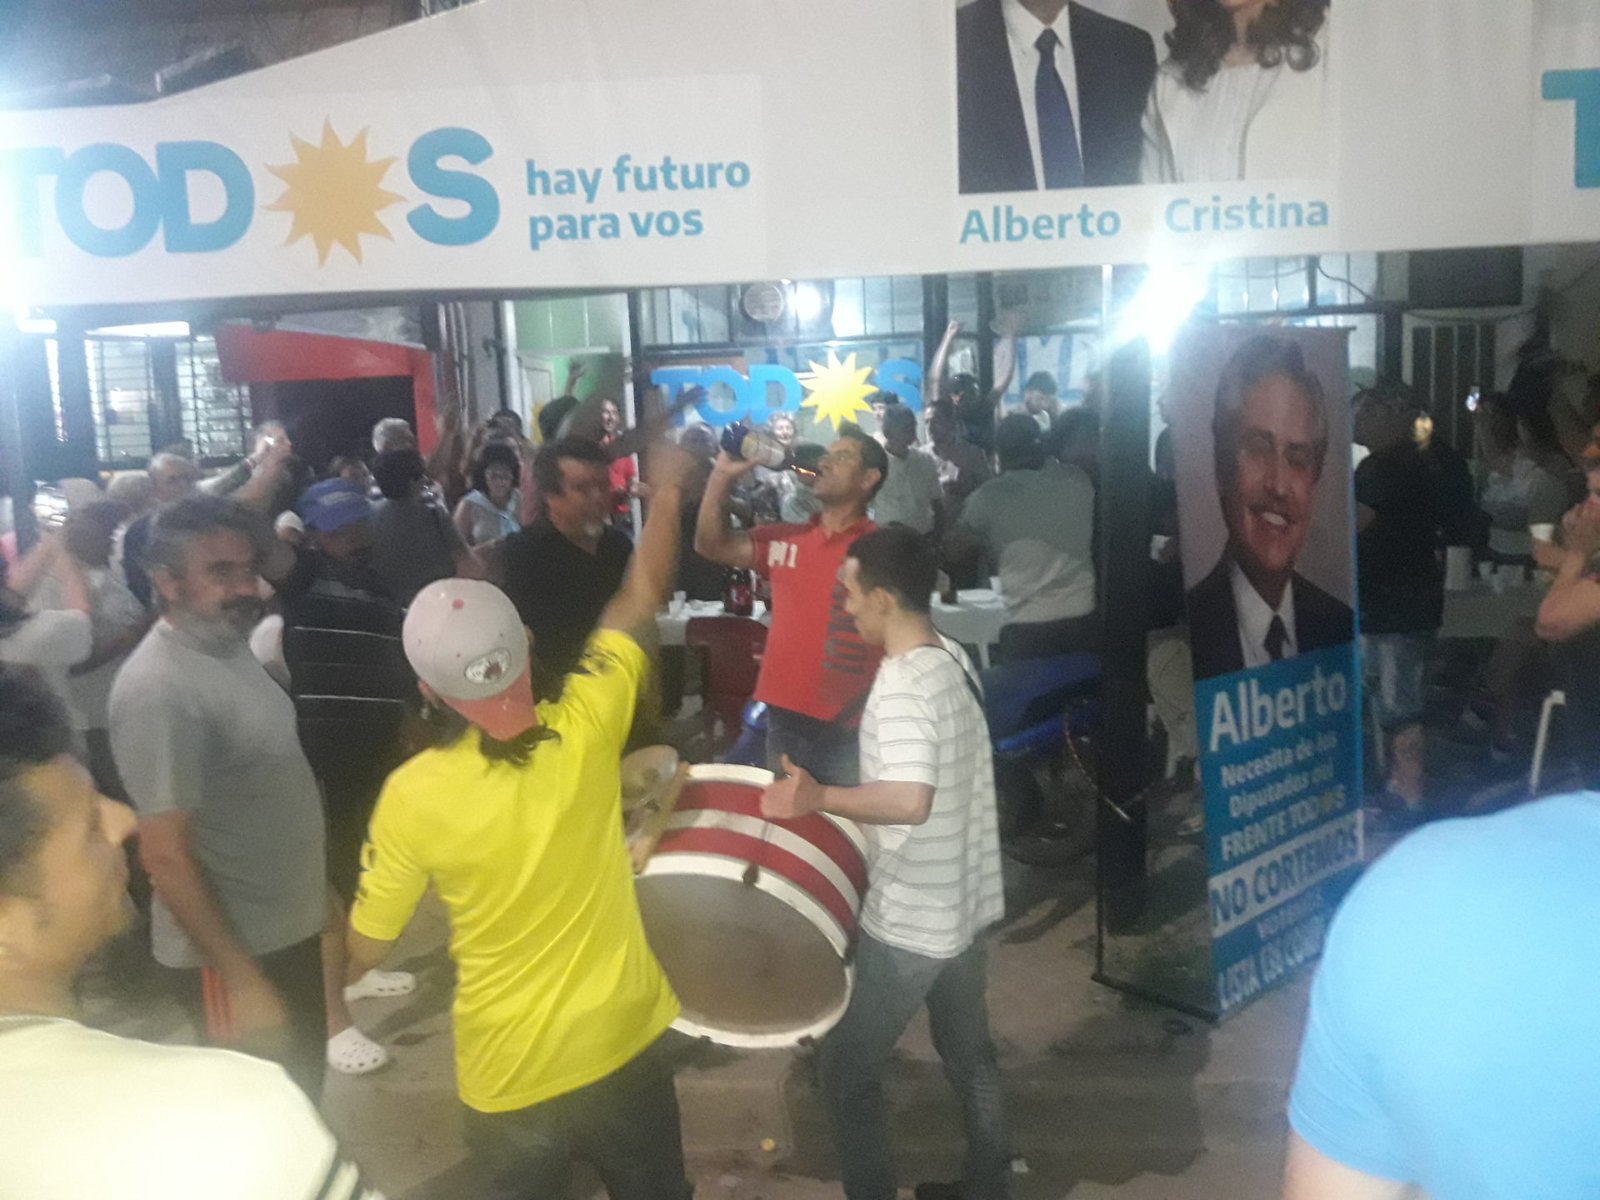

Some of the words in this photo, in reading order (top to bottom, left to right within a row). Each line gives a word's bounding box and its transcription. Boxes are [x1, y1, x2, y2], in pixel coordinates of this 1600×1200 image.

[525, 158, 602, 203] hay
[612, 153, 750, 193] futuro
[528, 209, 620, 251] para
[628, 208, 704, 238] vos
[959, 203, 1121, 244] Alberto
[1164, 193, 1329, 234] Cristina
[1210, 665, 1346, 752] Alberto
[1220, 809, 1288, 861] FRENTE
[1209, 875, 1249, 928] NO
[1254, 827, 1358, 905] CORTEMOS
